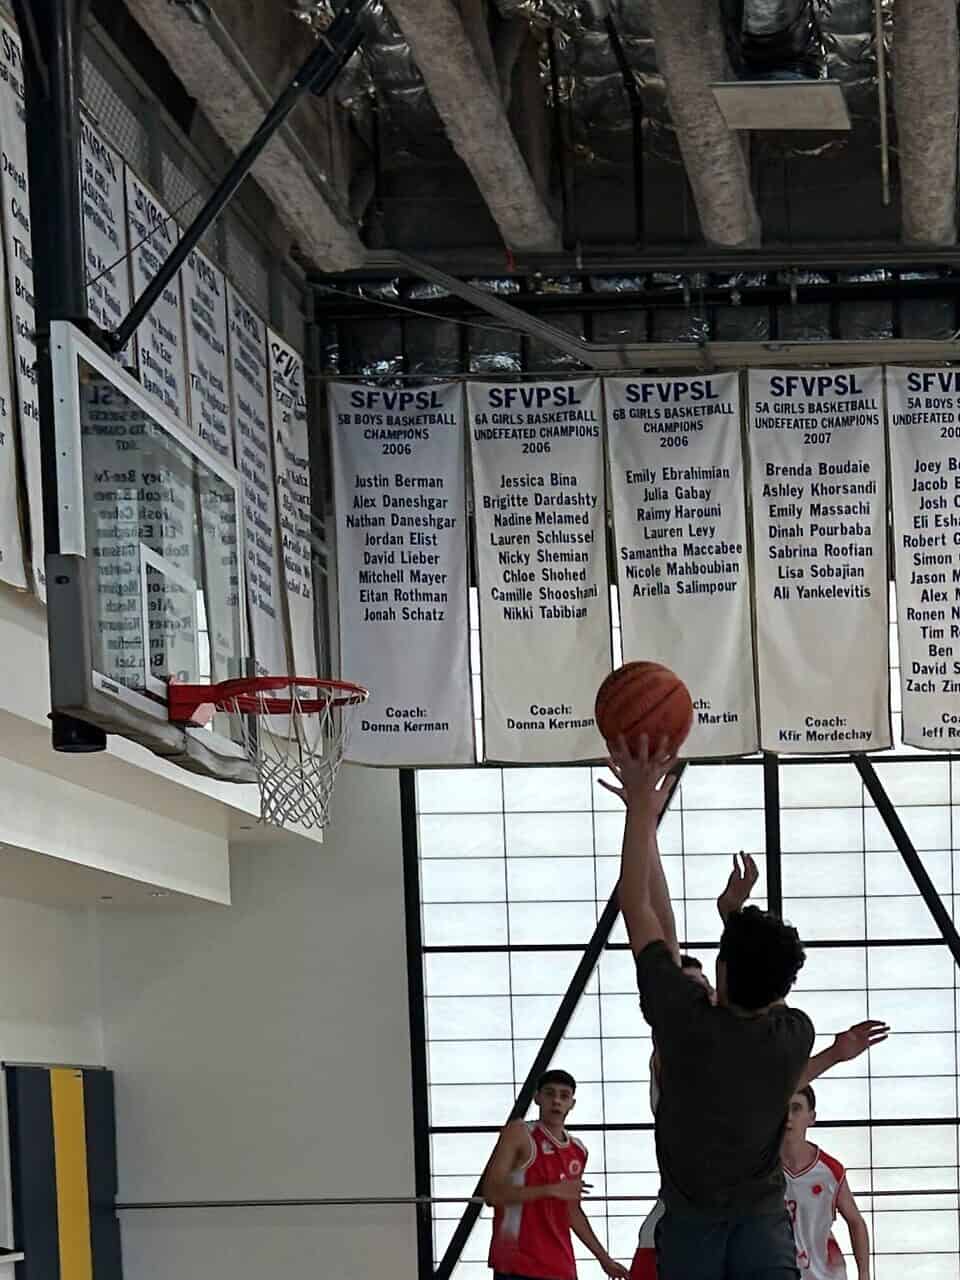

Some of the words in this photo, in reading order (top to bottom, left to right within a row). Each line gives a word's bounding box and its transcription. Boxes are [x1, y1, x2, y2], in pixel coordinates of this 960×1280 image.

[626, 381, 719, 402] SFVPSL
[770, 375, 862, 396] SFVPSL
[351, 390, 443, 410] SFVPSL
[488, 387, 581, 408] SFVPSL
[908, 398, 921, 409] 5A
[926, 398, 953, 408] BOYS
[613, 408, 626, 420] 6B
[629, 408, 660, 419] GIRLS
[664, 403, 734, 418] BASKETBALL
[756, 402, 770, 413] 5A
[774, 403, 804, 414] GIRLS
[808, 399, 878, 413] BASKETBALL
[336, 414, 350, 424] 5B
[354, 414, 383, 425] BOYS
[386, 413, 456, 426] BASKETBALL
[475, 413, 488, 425] 6A
[492, 414, 524, 424] GIRLS
[527, 410, 597, 424] BASKETBALL
[755, 418, 818, 429] UNDEFEATED
[821, 415, 879, 428] CHAMPIONS
[644, 420, 703, 432] CHAMPIONS
[364, 428, 429, 440] CHAMPIONS
[474, 428, 536, 440] UNDEFEATED
[540, 426, 599, 438] CHAMPIONS
[804, 432, 831, 444] 2007
[522, 442, 550, 453] 2006
[660, 436, 688, 447] 2006
[382, 443, 411, 455] 2006
[766, 463, 812, 476] Brenda
[818, 460, 870, 475] Boudaie
[914, 460, 941, 473] Joey
[500, 474, 544, 488] Jessica
[550, 473, 576, 486] Bina
[626, 469, 656, 484] Emily
[662, 466, 730, 480] Ebrahimian
[643, 488, 668, 502] Julia
[675, 486, 711, 501] Gabay
[354, 496, 376, 508] Alex
[383, 495, 448, 510] Daneshgar
[483, 494, 528, 510] Brigitte
[534, 492, 597, 507] Dardashty
[770, 504, 802, 519] Emily
[810, 502, 870, 516] Massachi
[914, 515, 928, 529] Eli
[364, 551, 394, 564] David
[401, 551, 440, 564] Lieber
[621, 545, 677, 560] Samantha
[683, 542, 742, 556] Maccabee
[769, 545, 817, 558] Sabrina
[824, 544, 872, 556] Roofian
[920, 626, 944, 639] Tim
[386, 707, 426, 718] Coach:
[530, 704, 571, 715] Coach:
[507, 719, 544, 729] Donna
[549, 717, 595, 730] Kerman
[698, 712, 738, 724] Martin
[805, 717, 846, 727] Coach:
[362, 721, 400, 732] Donna
[404, 722, 448, 732] Kerman
[922, 727, 943, 737] Jeff
[780, 730, 801, 741] Kfir
[806, 730, 872, 741] Mordechay
